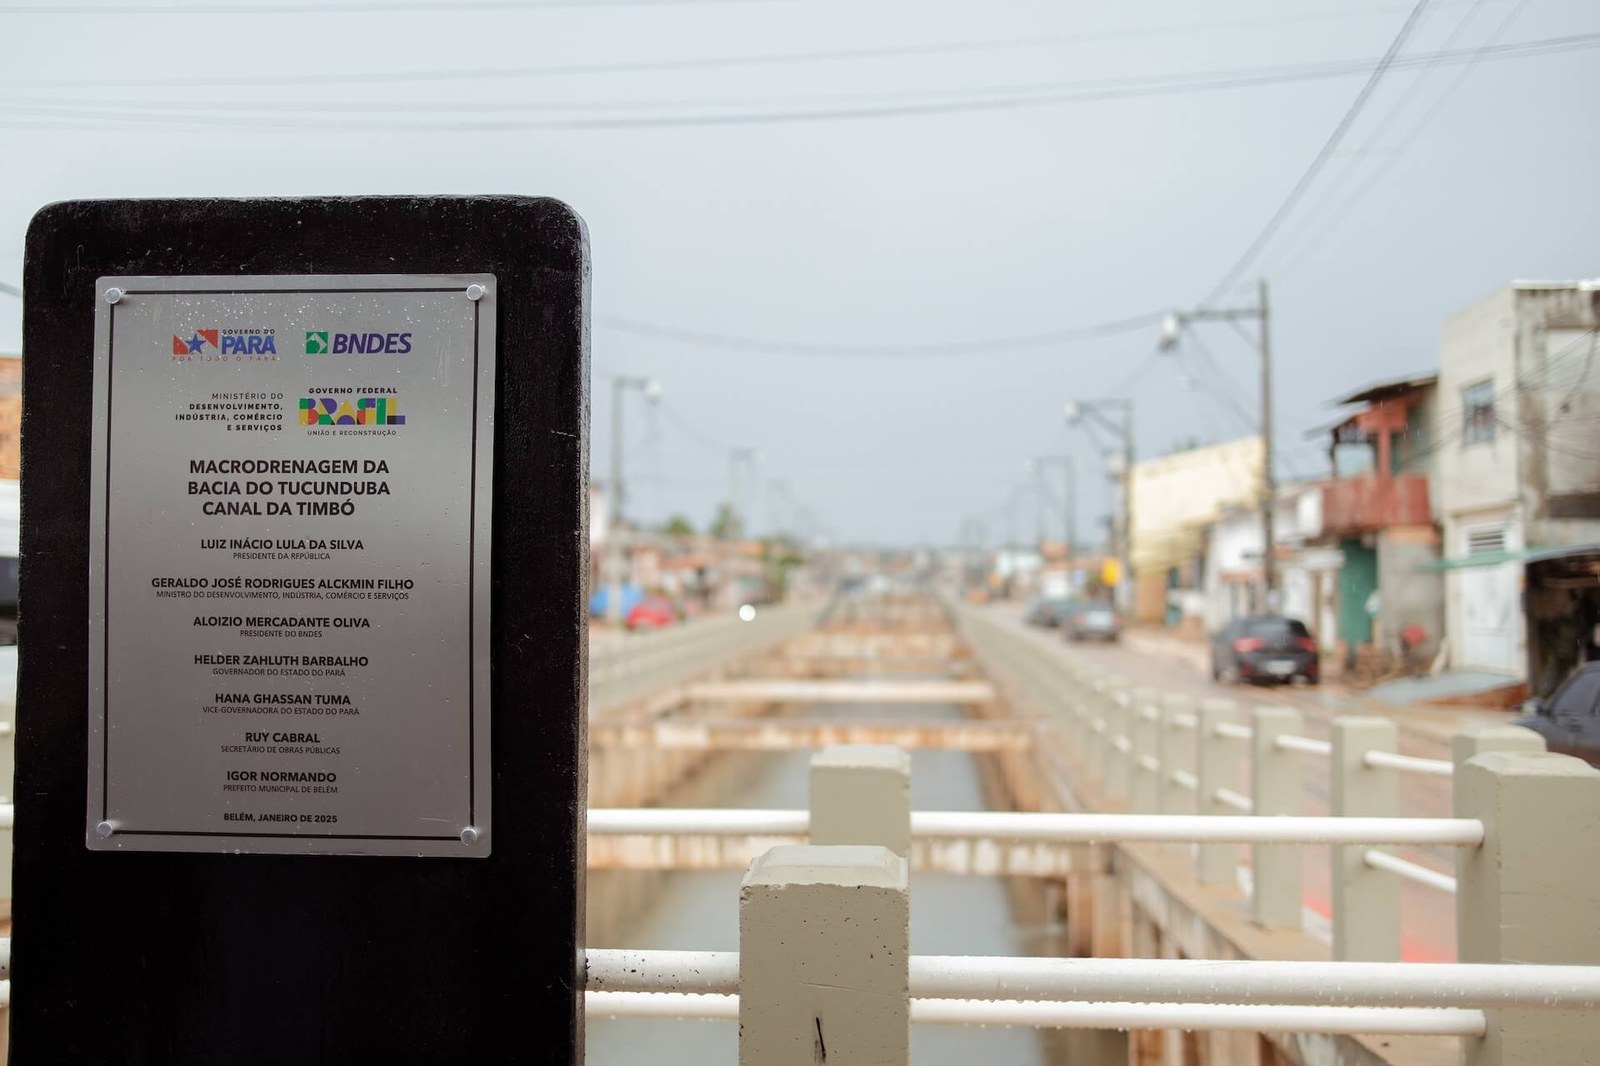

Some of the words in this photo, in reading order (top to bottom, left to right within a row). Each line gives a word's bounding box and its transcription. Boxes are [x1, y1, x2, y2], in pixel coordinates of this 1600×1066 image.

[332, 332, 412, 354] BNDES
[212, 390, 267, 400] MINISTÉRIO
[270, 392, 284, 400] DO
[189, 403, 283, 411] DESENVOLVIMENTO,
[175, 411, 230, 422] INDÚSTRIA,
[233, 412, 283, 421] COMÉRCIO
[236, 424, 282, 433] SERVIÇOS
[307, 428, 330, 436] UNIÃO
[339, 428, 397, 438] RECONSTRUÇÃO
[189, 460, 358, 474] MACRODRENAGEM
[363, 460, 390, 474] DA
[188, 481, 241, 495] BACIA
[246, 481, 273, 496] DO
[278, 481, 390, 496] TUCUNDUBA
[202, 501, 262, 516] CANAL
[266, 502, 292, 516] DA
[296, 498, 355, 517] TIMBÓ
[200, 539, 227, 549] LUIZ
[230, 537, 273, 550] INÁCIO
[276, 539, 305, 550] LULA
[309, 539, 327, 550] DA
[329, 539, 364, 550] SILVA
[233, 552, 276, 560] PRESIDENTE
[290, 551, 331, 560] REPÚBLICA
[151, 577, 209, 588] GERALDO
[211, 576, 242, 589] JOSÉ
[245, 578, 315, 589] RODRIGUES
[317, 579, 374, 590] ALCKMIN
[377, 579, 414, 590] FILHO
[156, 590, 192, 599] MINISTRO
[193, 591, 205, 599] DO
[206, 591, 281, 600] DESENVOLVIMENTO,
[325, 590, 366, 600] COMÉRCIO
[367, 592, 372, 600] E
[193, 616, 243, 627] ALOIZIO
[245, 617, 330, 628] MERCADANTE
[332, 618, 370, 628] OLIVA
[240, 630, 283, 638] PRESIDENTE
[284, 630, 296, 638] DO
[298, 630, 323, 638] BNDES
[194, 655, 240, 665] HELDER
[243, 656, 299, 666] ZAHLUTH
[302, 656, 368, 667] BARBALHO
[212, 668, 265, 676] GOVERNADOR
[266, 668, 279, 676] DO
[280, 668, 310, 676] ESTADO
[311, 669, 324, 677] DO
[325, 667, 346, 677] PARÁ
[215, 693, 251, 704] HANA
[253, 694, 312, 705] GHASSAN
[314, 694, 351, 705] TUMA
[202, 706, 279, 715] VICE-GOVERNADORA
[280, 707, 293, 715] DO
[294, 707, 324, 715] ESTADO
[325, 707, 338, 716] DO
[339, 706, 360, 716] PARÁ
[245, 732, 270, 743] RUY
[272, 732, 321, 743] CABRAL
[221, 744, 265, 754] SECRETÁRIO
[266, 746, 277, 754] DE
[278, 746, 304, 754] OBRAS
[305, 744, 341, 755] PÚBLICAS
[227, 771, 258, 782] IGOR
[260, 772, 337, 783] NORMANDO
[223, 784, 257, 792] PREFEITO
[258, 785, 300, 793] MUNICIPAL
[301, 785, 312, 793] DE
[313, 784, 338, 794] BELÉM
[223, 811, 256, 823] BELÉM,
[257, 813, 298, 823] JANEIRO
[300, 814, 313, 823] DE
[314, 814, 338, 823] 2025
